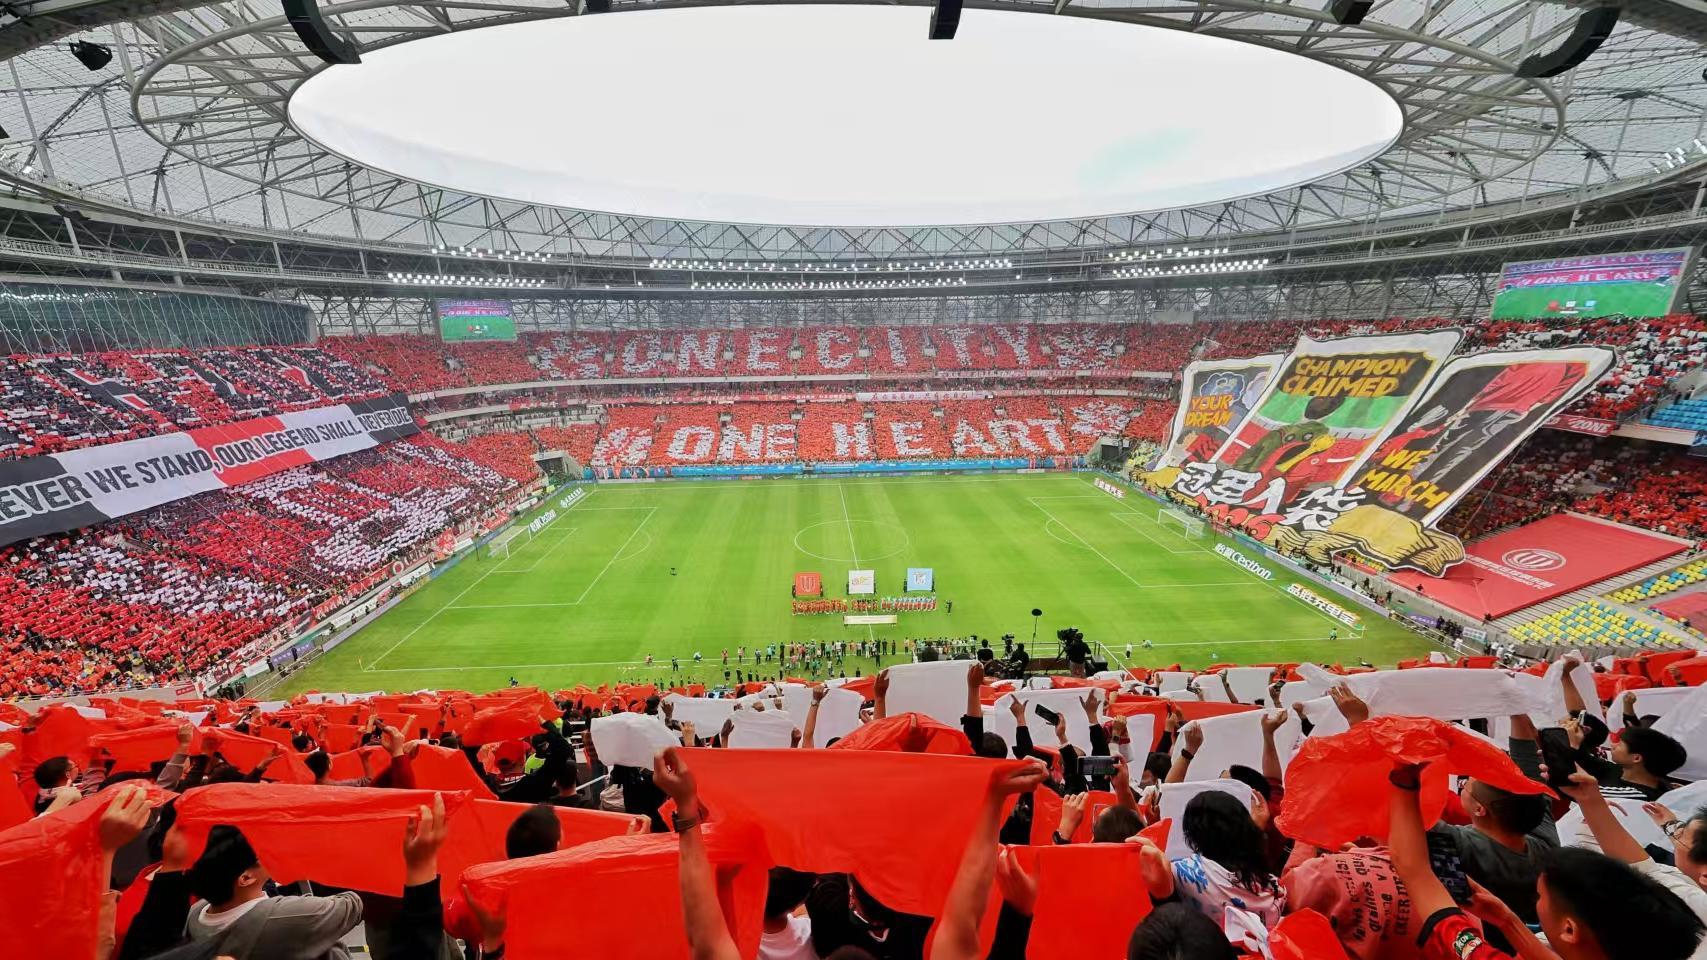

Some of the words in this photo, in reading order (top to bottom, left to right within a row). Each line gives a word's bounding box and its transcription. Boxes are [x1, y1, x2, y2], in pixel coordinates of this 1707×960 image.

[1535, 275, 1569, 285] ONE
[1578, 271, 1649, 282] HEART
[622, 331, 781, 375] ONE
[817, 326, 1031, 371] CITY
[1295, 357, 1417, 378] CHAMPION
[1282, 374, 1400, 398] CLAIMED
[1191, 394, 1233, 411] YOUR
[1184, 411, 1236, 428] DREAM
[667, 423, 797, 463] ONE
[831, 418, 1067, 458] HEART
[0, 475, 93, 521] EVER
[85, 465, 139, 494] WE
[134, 449, 222, 484] STAND,
[215, 438, 260, 467] OUR
[255, 426, 321, 456] LEGEND
[317, 419, 361, 441] SHALL
[357, 409, 395, 432] NEVER
[393, 406, 412, 425] DIE
[1381, 448, 1434, 470] WE
[1356, 469, 1451, 510] MARCH
